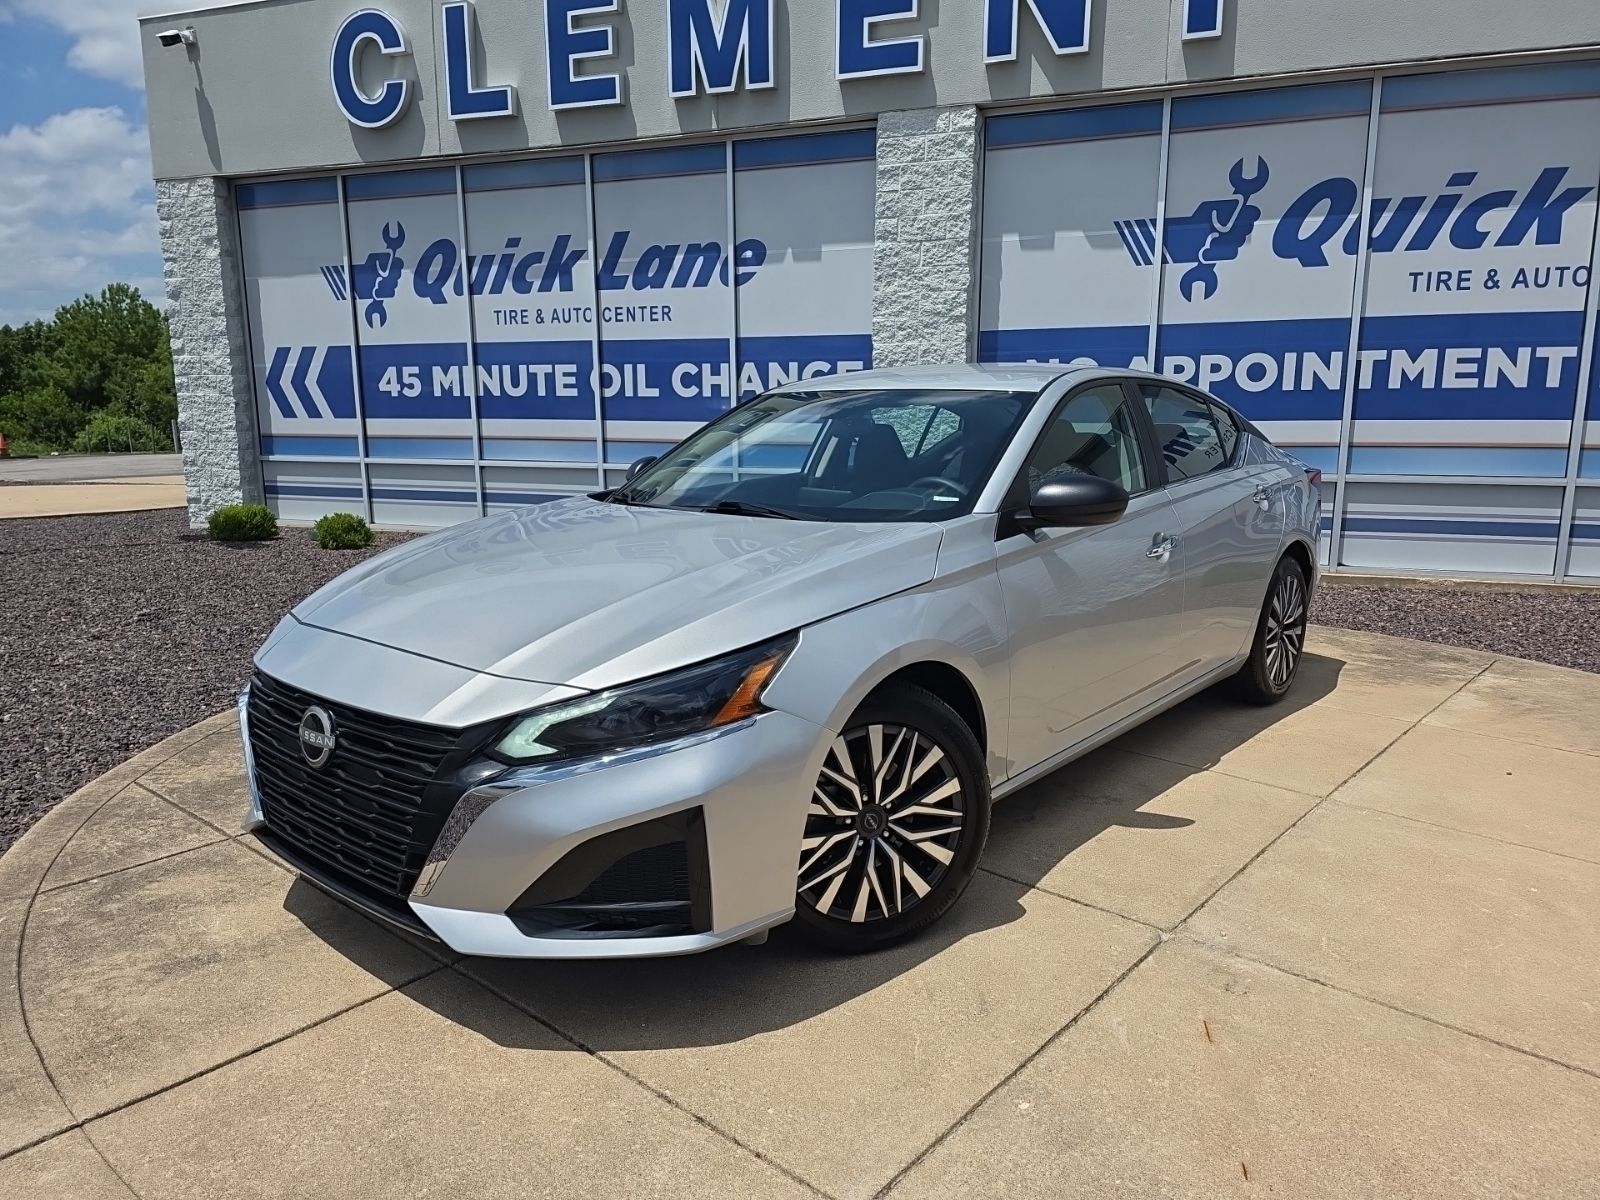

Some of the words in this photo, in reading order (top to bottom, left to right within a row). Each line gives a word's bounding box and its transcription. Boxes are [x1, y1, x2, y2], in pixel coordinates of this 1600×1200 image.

[1272, 166, 1596, 268] Quick
[413, 234, 588, 304] Quick
[597, 230, 768, 291] Lane
[1408, 269, 1473, 293] TIRE
[1483, 268, 1501, 290] &
[1511, 265, 1591, 290] AUTO
[493, 309, 529, 326] TIRE
[535, 308, 545, 324] &
[551, 307, 592, 324] AUTO
[602, 305, 672, 323] CENTER
[378, 365, 422, 398] 45
[432, 363, 579, 397] MINUTE
[589, 363, 660, 398] OIL
